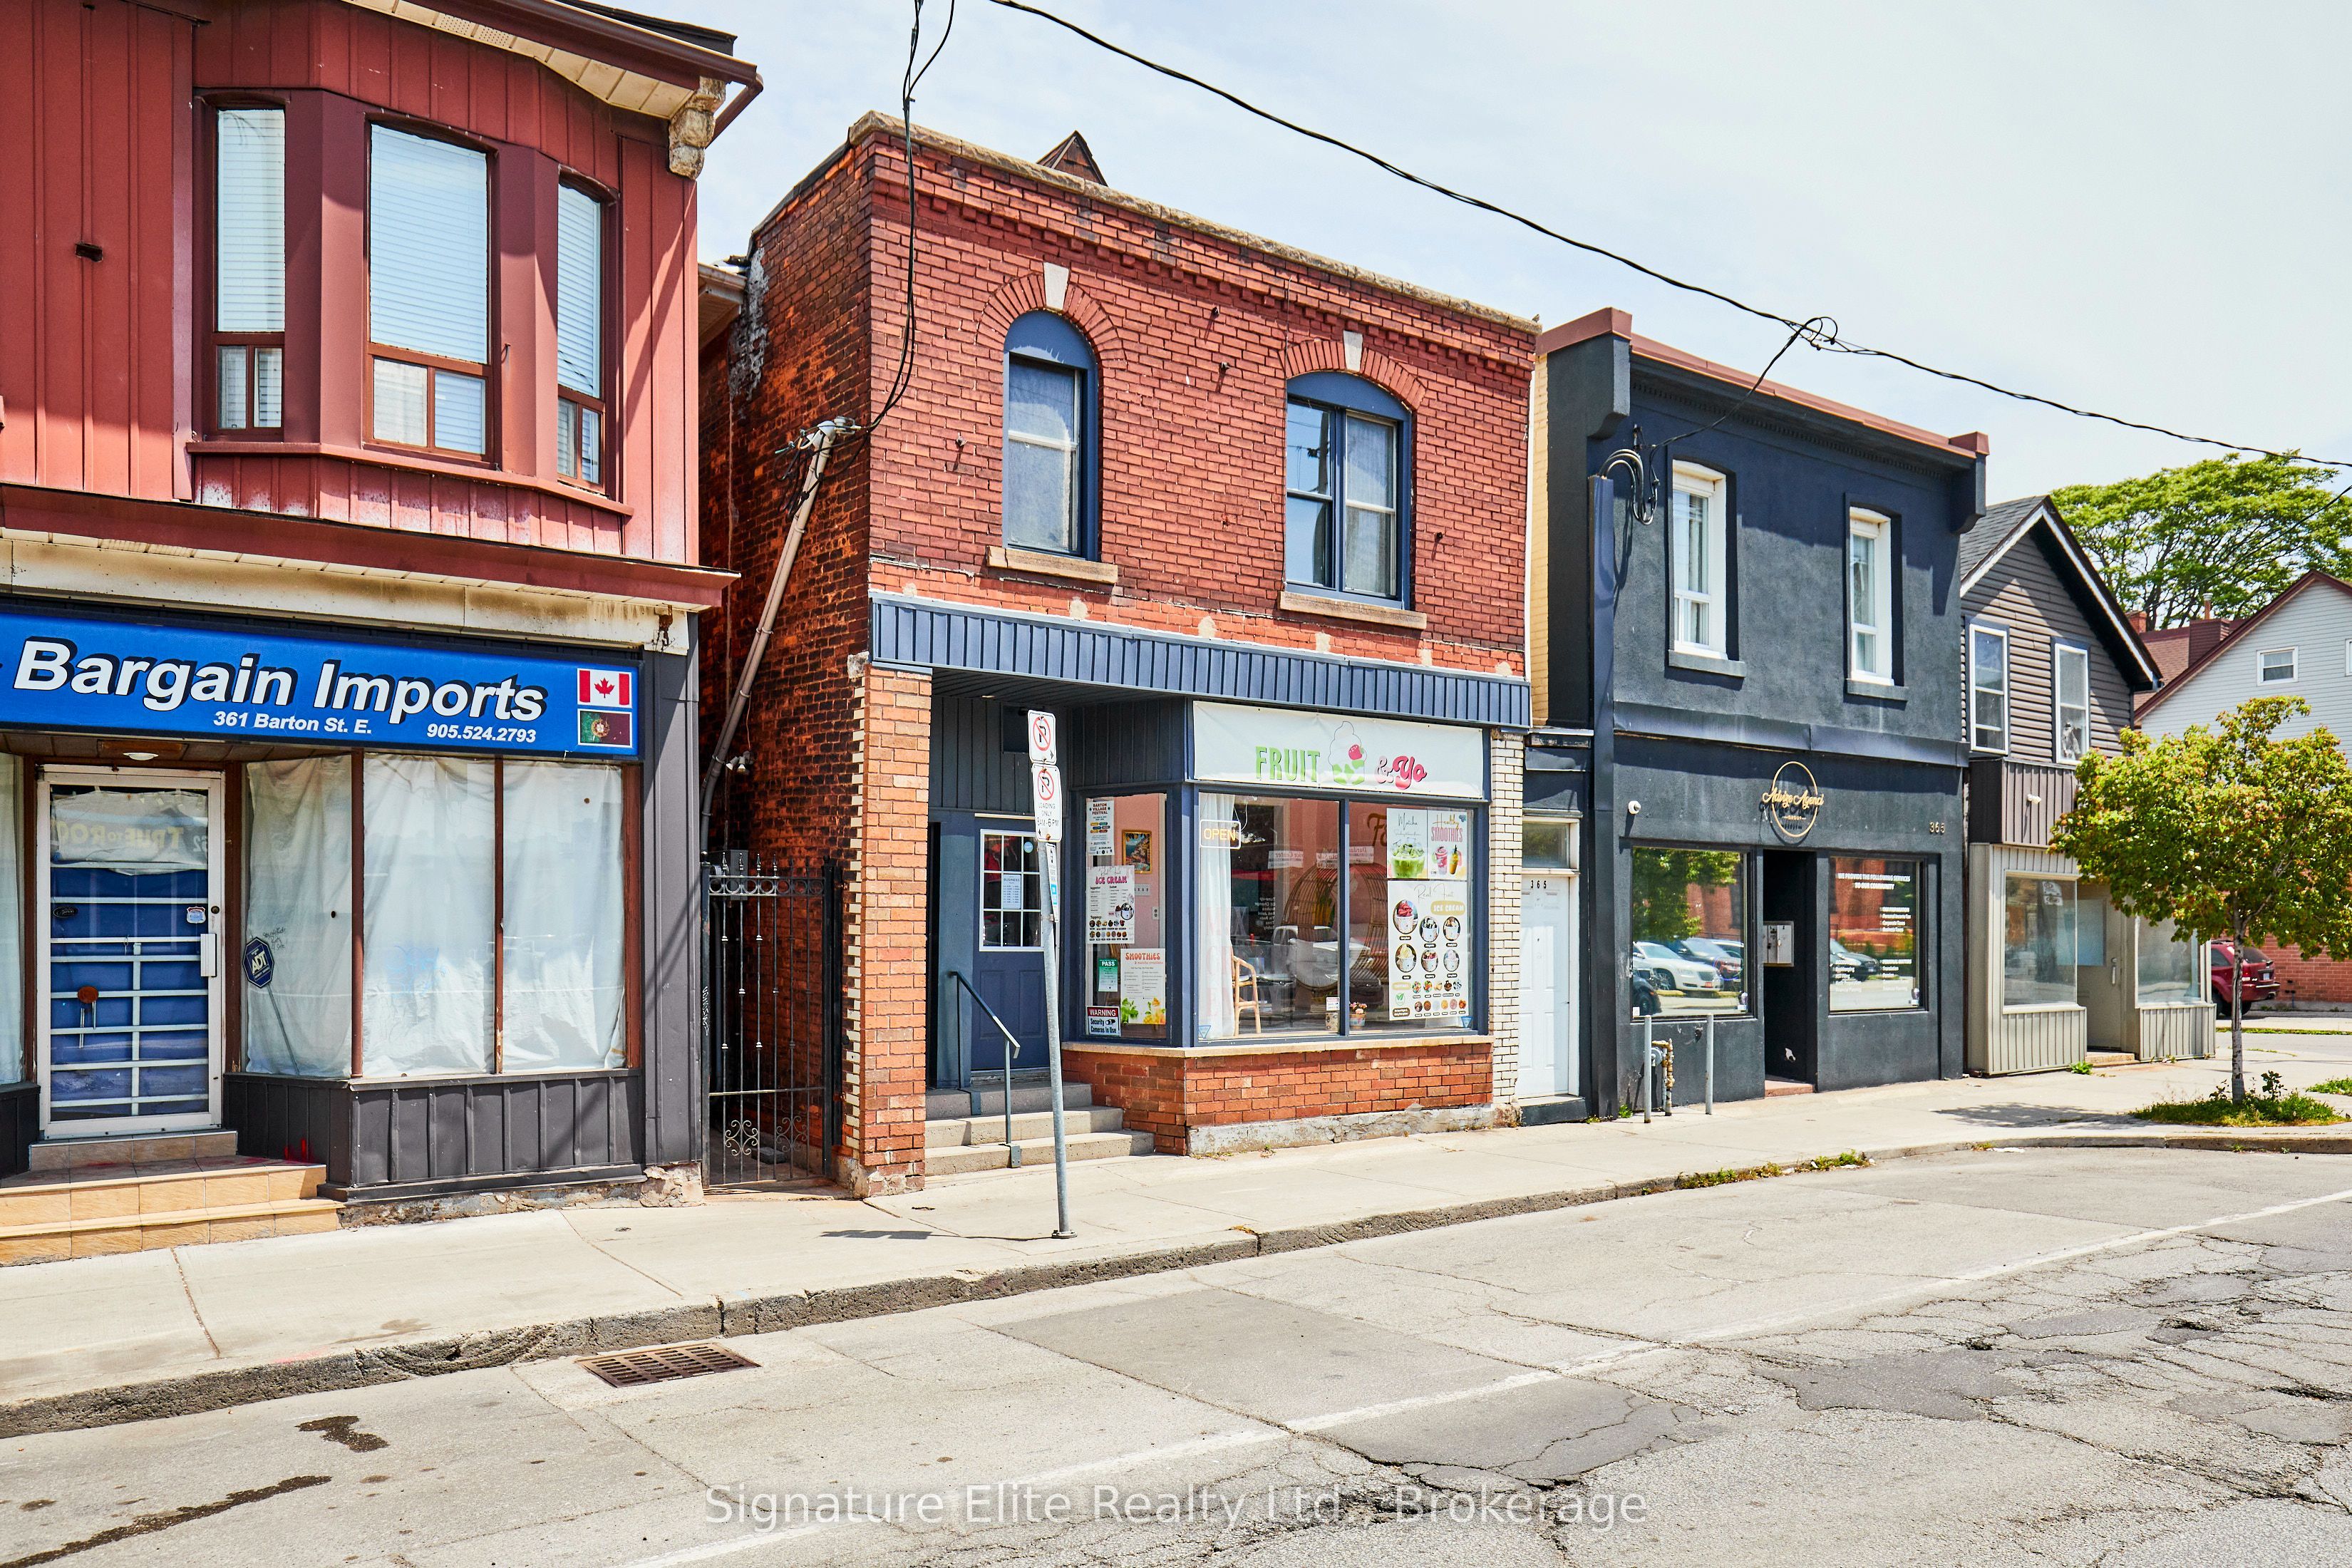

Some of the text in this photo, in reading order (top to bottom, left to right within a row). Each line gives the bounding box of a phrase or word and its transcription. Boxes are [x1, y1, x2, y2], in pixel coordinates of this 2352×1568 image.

[14, 639, 545, 724] Bargain Imports
[213, 711, 371, 733] 361 Barton St. E.
[427, 723, 537, 743] 905.524.2793
[1255, 746, 1320, 783] FRUIT
[1393, 756, 1427, 790] Yo
[1398, 813, 1418, 830] Matcha
[1433, 813, 1460, 830] Healthy
[1929, 822, 1945, 833] 365
[1203, 827, 1236, 842] OPEN
[1431, 827, 1463, 842] SMOOTHIES
[1095, 875, 1127, 884] ICE CREAM
[1531, 880, 1547, 889] 365
[252, 951, 267, 974] ADT
